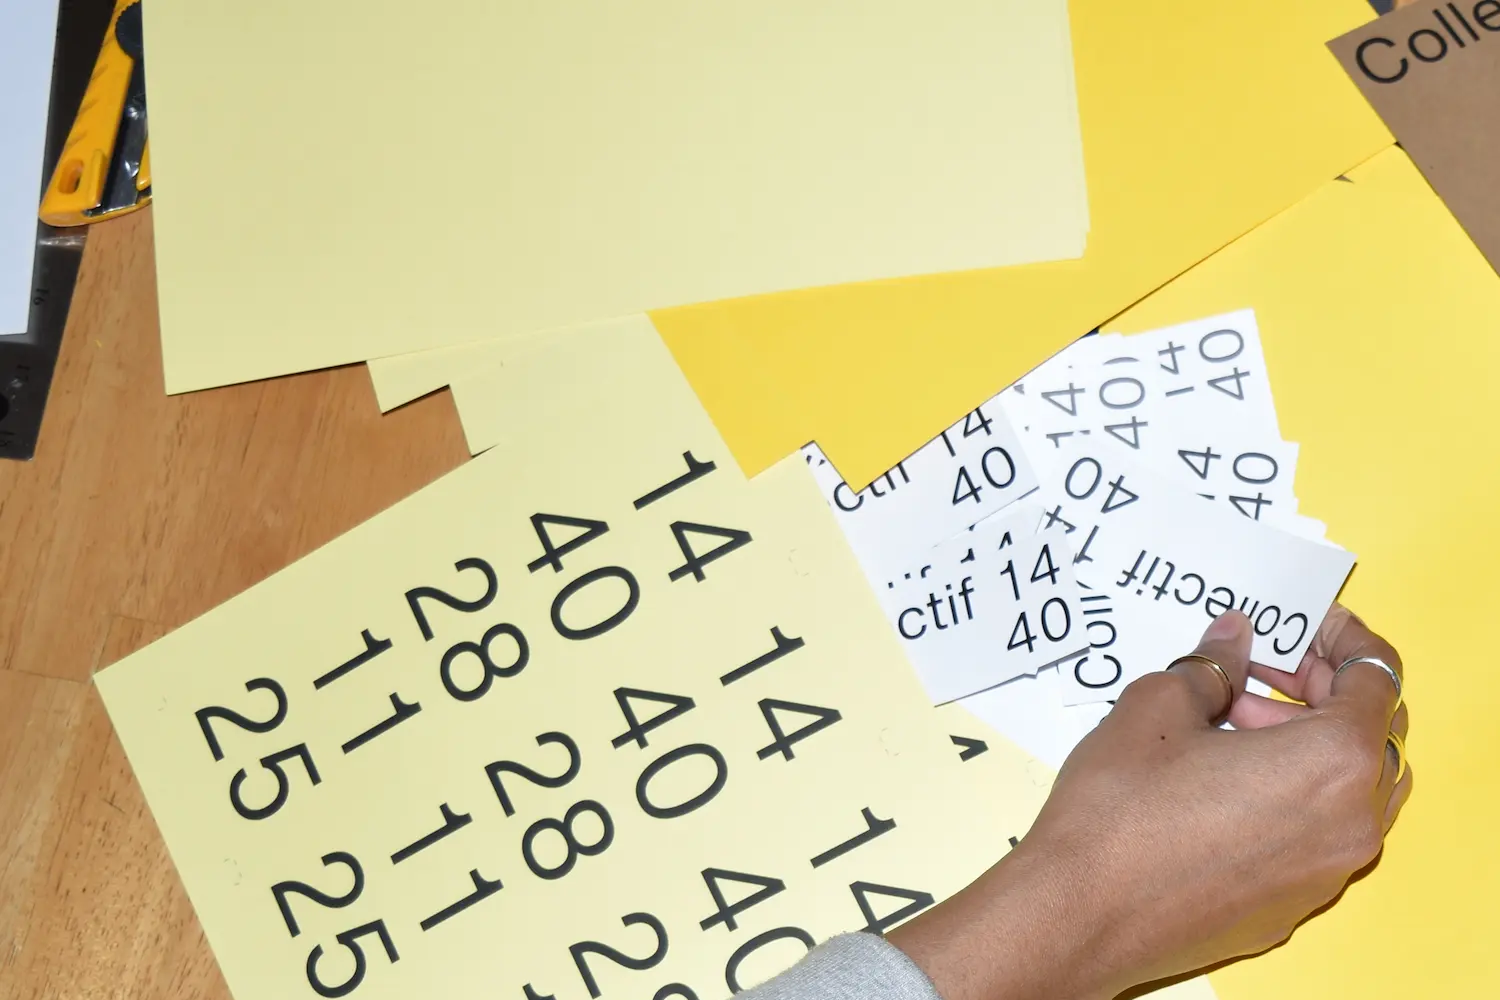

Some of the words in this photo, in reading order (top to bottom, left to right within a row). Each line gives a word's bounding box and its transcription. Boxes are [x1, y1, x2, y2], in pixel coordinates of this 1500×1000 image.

[1099, 377, 1149, 449] 40
[1198, 329, 1251, 400] 40
[632, 450, 754, 584] 14
[952, 446, 1016, 505] 40
[1065, 457, 1139, 514] 40
[1228, 452, 1278, 520] 40
[404, 556, 530, 702] 28
[526, 512, 641, 641] 40
[897, 576, 975, 640] ctif
[1000, 543, 1060, 601] 14
[1007, 597, 1072, 653] 40
[195, 676, 322, 821] 25
[313, 628, 422, 755] 11
[610, 686, 728, 819] 40
[719, 625, 843, 763] 14
[389, 802, 504, 933] 11
[483, 731, 615, 881] 28
[810, 806, 935, 935] 14
[270, 851, 401, 998] 25
[699, 867, 818, 994] 40
